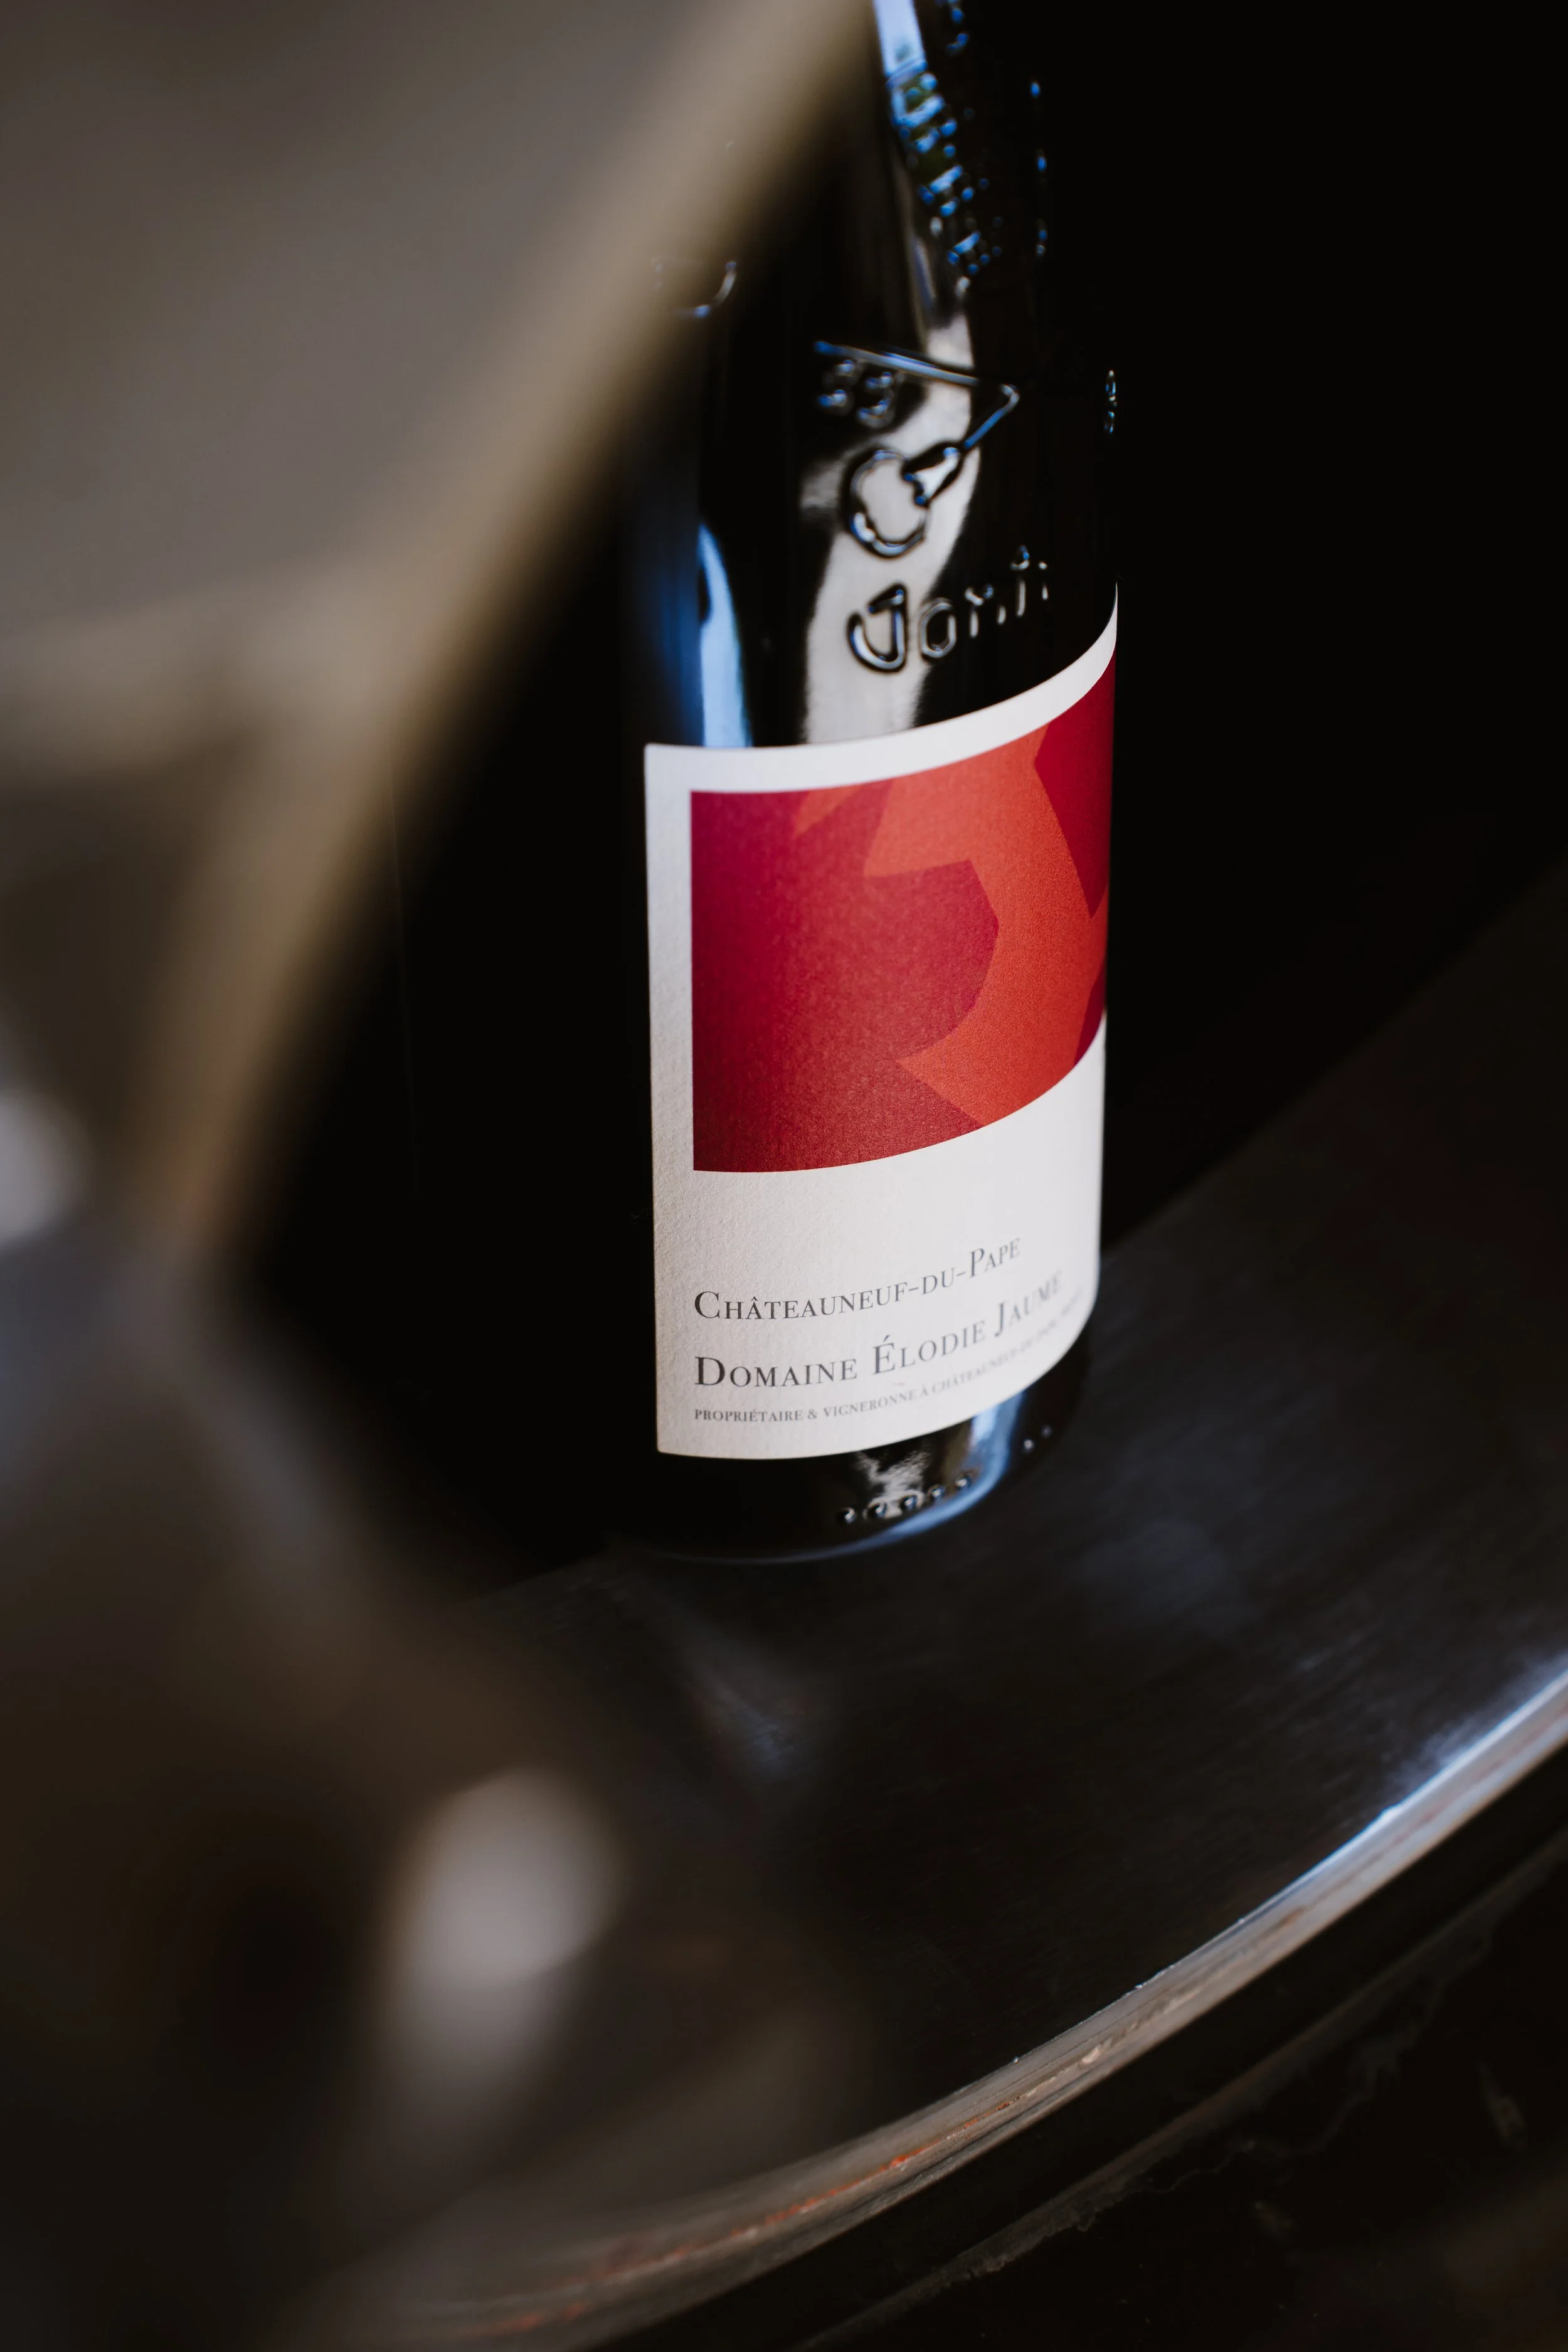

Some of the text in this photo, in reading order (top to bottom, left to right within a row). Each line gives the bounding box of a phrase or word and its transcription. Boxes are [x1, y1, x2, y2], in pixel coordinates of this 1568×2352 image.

[694, 1356, 857, 1387] DOMAINE
[872, 1320, 986, 1375] ÉLODIE
[994, 1270, 1063, 1337] JAUME
[694, 1409, 803, 1423] PROPRIÉTAIRE
[807, 1409, 818, 1419] &
[823, 1390, 919, 1417] VIGNERONNE
